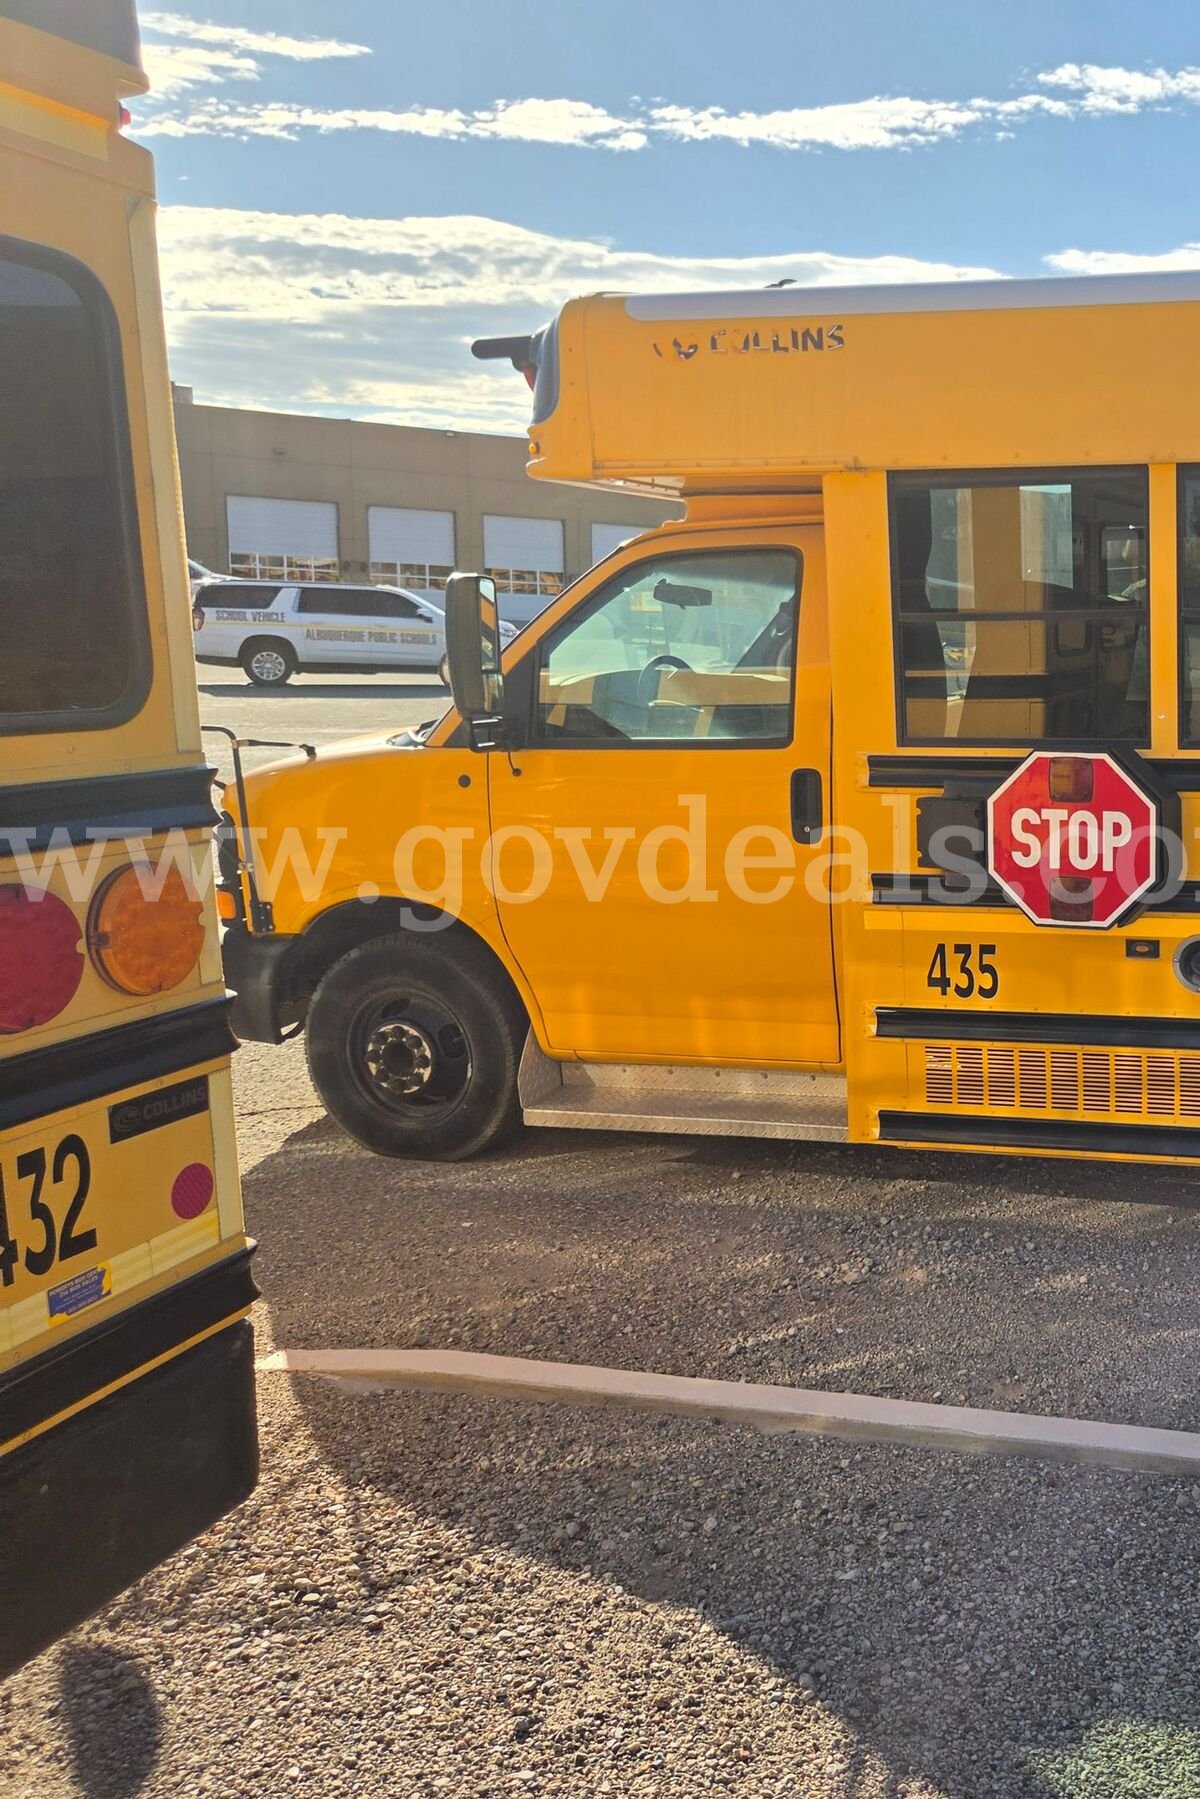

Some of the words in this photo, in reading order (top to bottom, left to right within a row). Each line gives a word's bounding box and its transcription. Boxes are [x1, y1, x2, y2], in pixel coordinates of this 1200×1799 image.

[215, 609, 249, 622] SCHOOL
[251, 611, 287, 623] VEHICLE
[305, 628, 367, 643] ALBUQUERQUE
[368, 630, 399, 644] PUBLIC
[401, 632, 438, 646] SCHOOLS
[1011, 807, 1132, 872] STOP
[927, 942, 999, 999] 435
[142, 1085, 207, 1121] COLLINS
